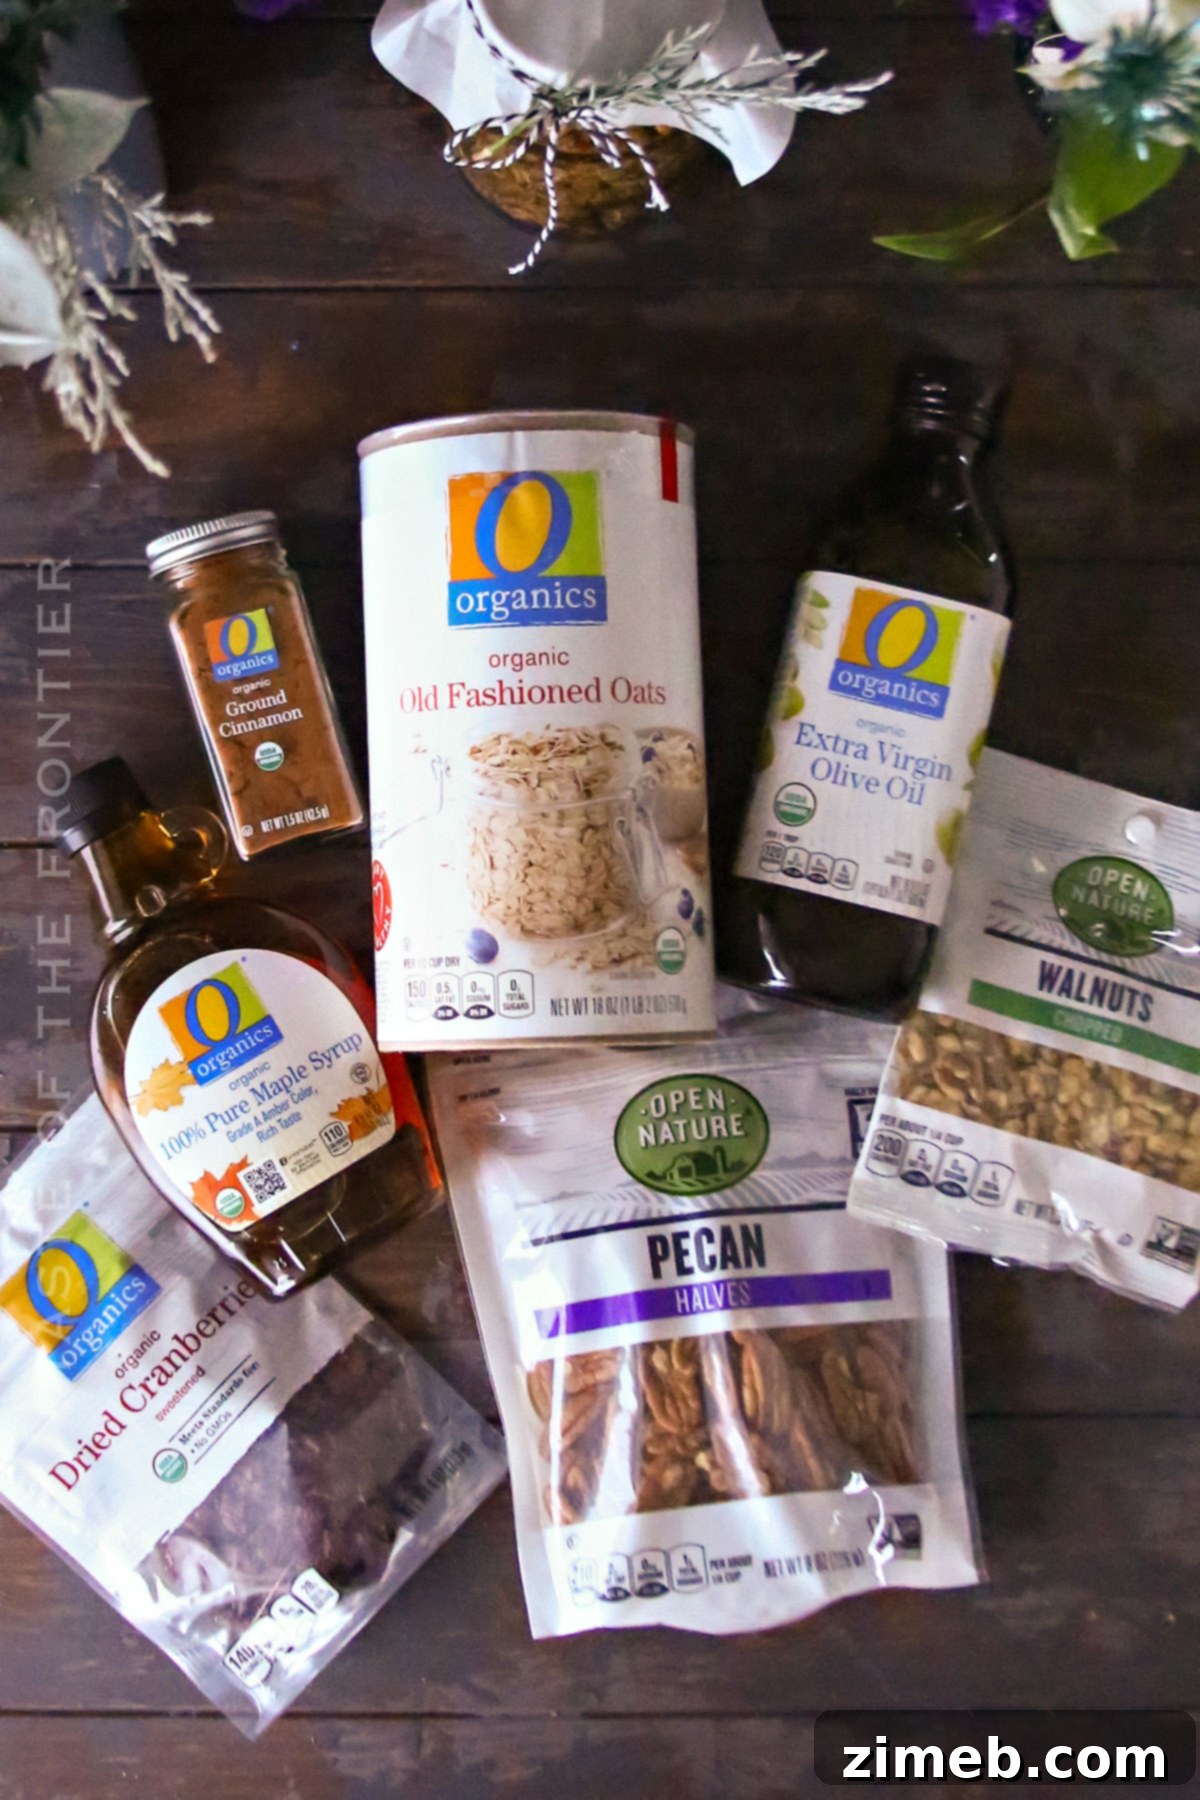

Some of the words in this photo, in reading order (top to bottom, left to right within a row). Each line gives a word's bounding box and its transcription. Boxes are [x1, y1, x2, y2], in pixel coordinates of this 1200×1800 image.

[456, 582, 597, 620] organics
[216, 653, 275, 677] organics
[489, 646, 570, 672] organic
[225, 690, 287, 718] Ground
[232, 678, 271, 695] organic
[400, 684, 439, 713] Old
[447, 677, 601, 710] Fashioned
[611, 677, 666, 704] Oats
[838, 667, 940, 708] organics
[219, 706, 303, 738] Cinnamon
[794, 722, 869, 760] Extra
[878, 740, 952, 781] Virgin
[810, 757, 879, 794] Olive
[886, 775, 926, 806] Oil
[1087, 866, 1149, 900] OPEN
[1071, 884, 1157, 926] NATURE
[445, 956, 461, 967] DRY
[407, 981, 427, 998] 150
[550, 998, 570, 1016] NET
[572, 997, 588, 1015] WT
[1038, 960, 1154, 1022] WALNUTS
[197, 1023, 273, 1077] organics
[228, 1061, 271, 1091] organic
[160, 1118, 207, 1161] 100%
[204, 1096, 251, 1133] Pure
[250, 1063, 308, 1108] Maple
[309, 1032, 363, 1072] Syrup
[651, 1088, 724, 1119] OPEN
[226, 1120, 254, 1144] Grade
[253, 1116, 263, 1128] A
[262, 1099, 290, 1122] Amber
[290, 1086, 318, 1104] Color,
[256, 1124, 278, 1143] Rich
[277, 1111, 303, 1130] Taste
[638, 1113, 745, 1148] NATURE
[323, 1125, 344, 1143] 110
[874, 1134, 902, 1156] 200
[647, 1224, 767, 1279] PECAN
[675, 1280, 751, 1314] HALVES
[60, 1276, 147, 1369] organics
[114, 1329, 161, 1379] organic
[49, 1411, 128, 1491] Dried
[118, 1276, 256, 1414] Cranberrie
[156, 1364, 206, 1423] sweetened
[178, 1420, 204, 1446] Meets
[202, 1377, 244, 1418] Standards
[229, 1645, 256, 1670] 140
